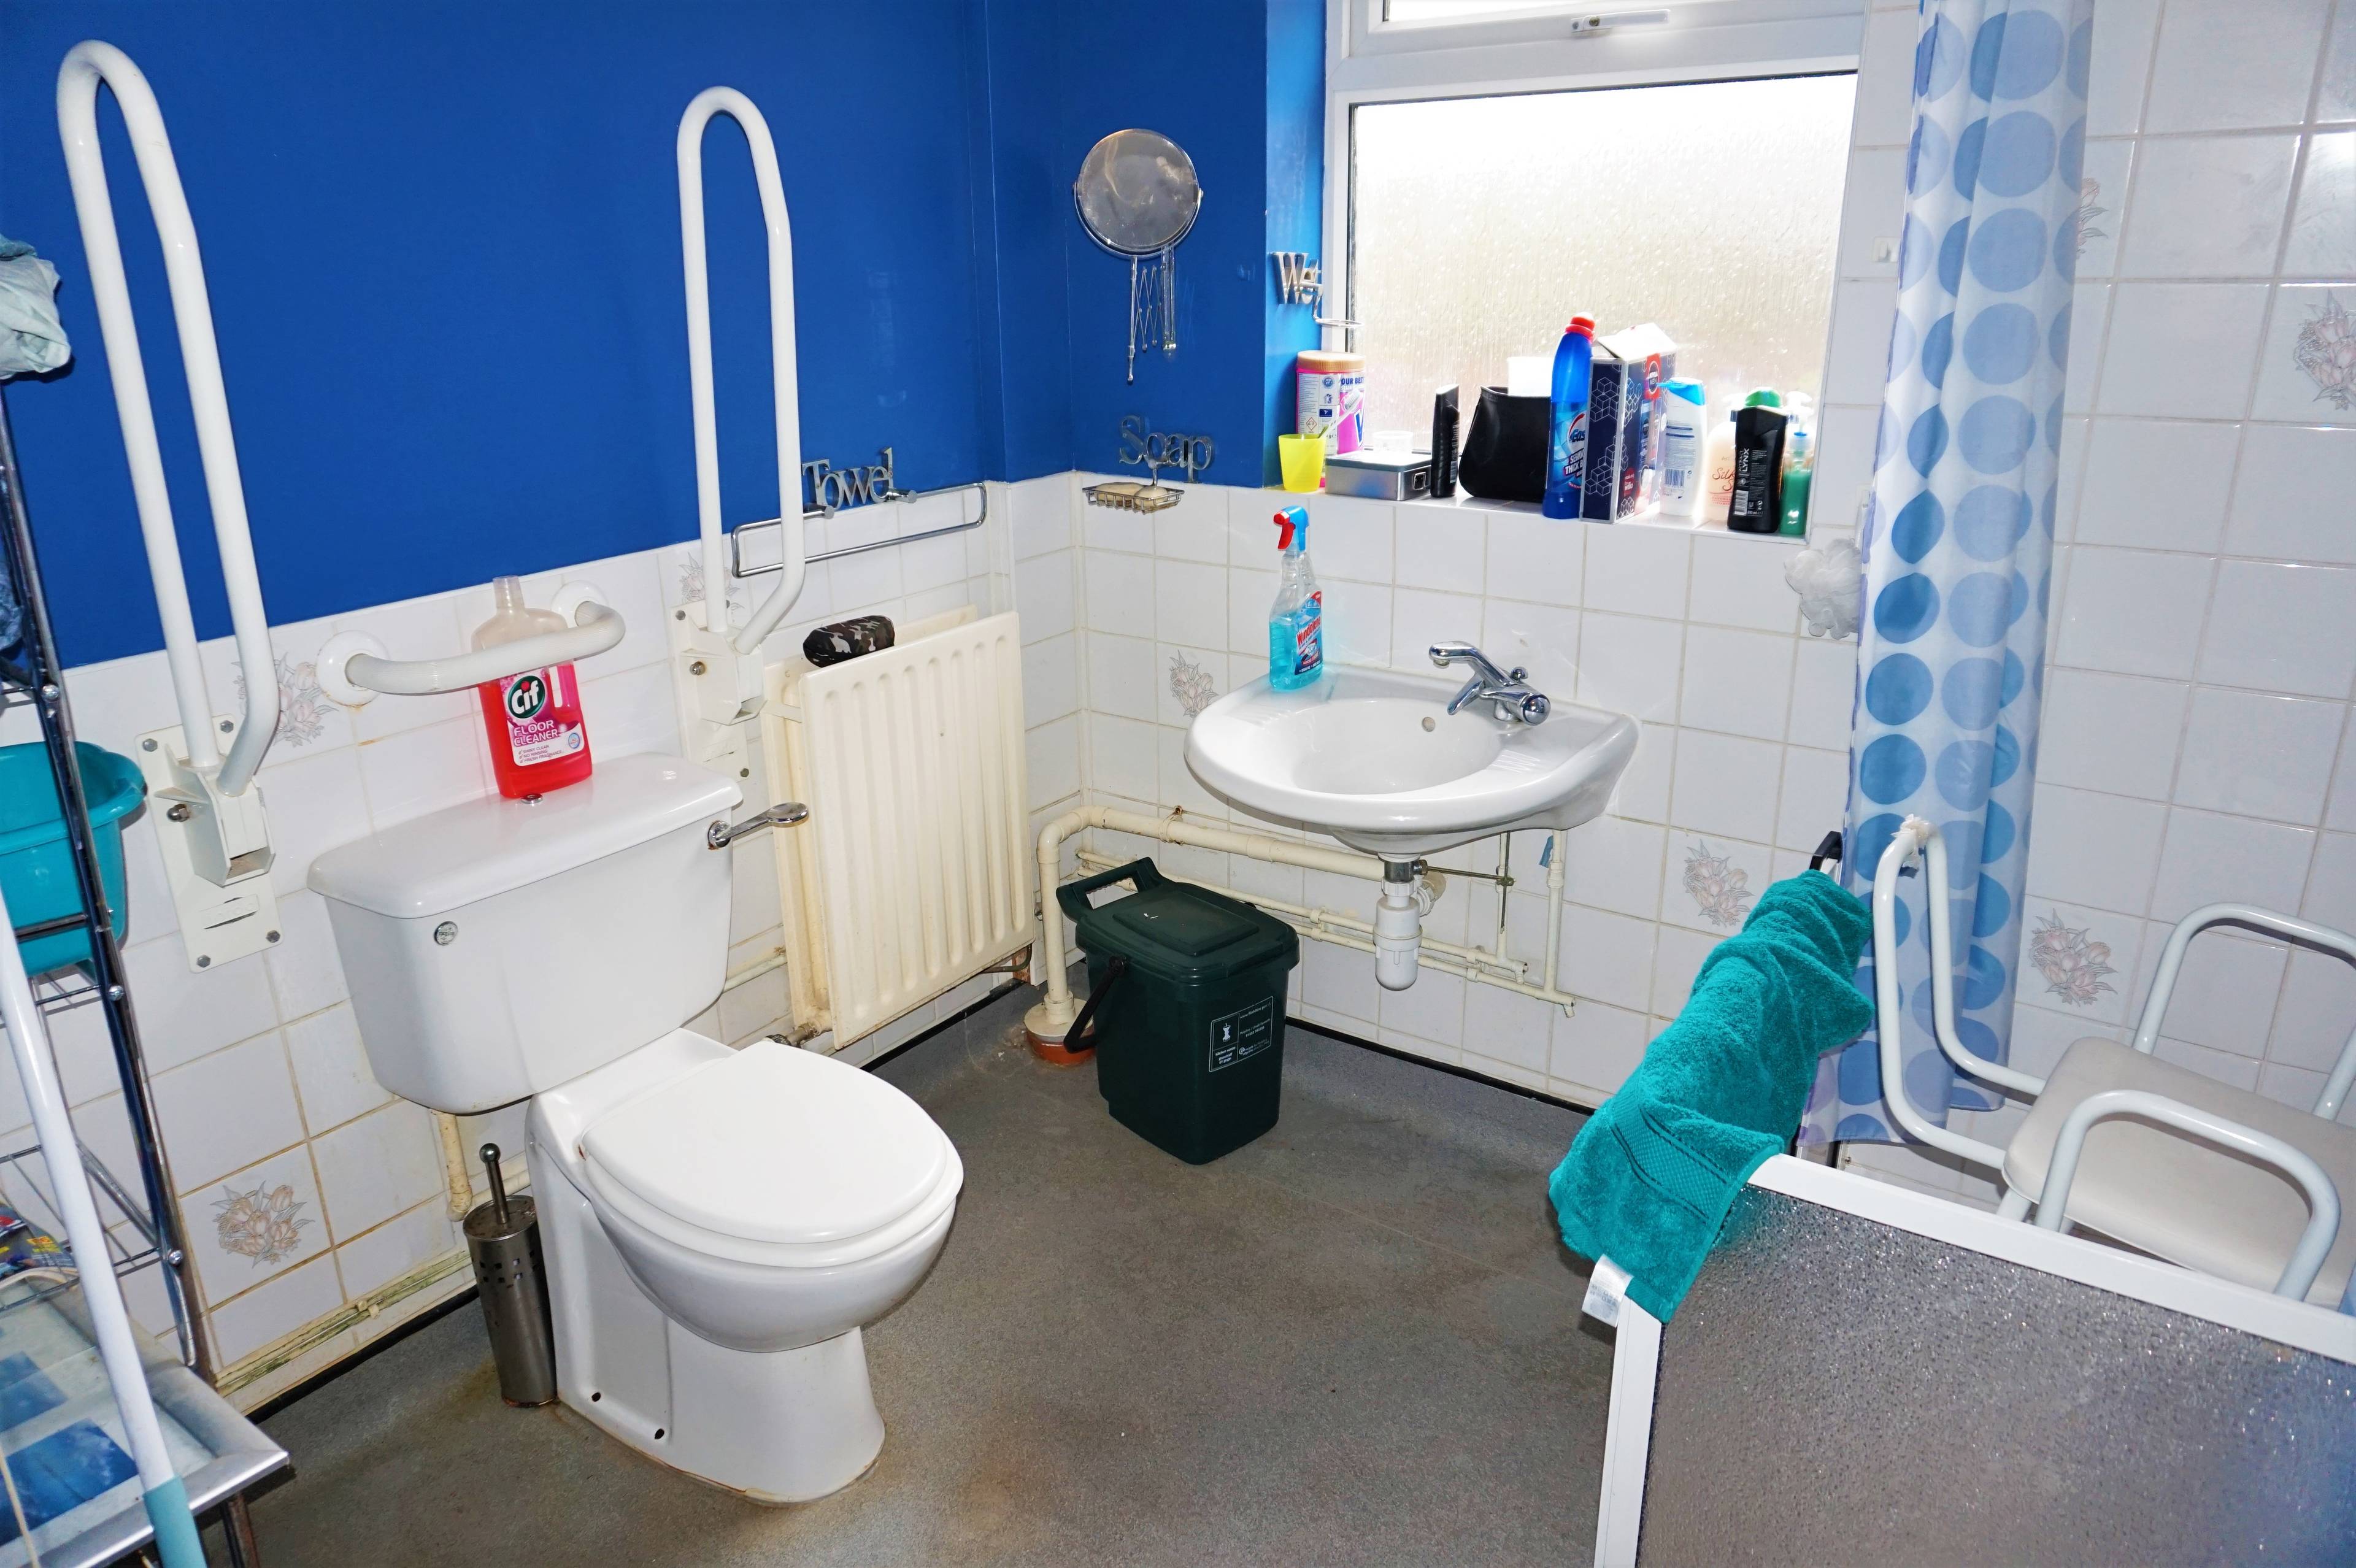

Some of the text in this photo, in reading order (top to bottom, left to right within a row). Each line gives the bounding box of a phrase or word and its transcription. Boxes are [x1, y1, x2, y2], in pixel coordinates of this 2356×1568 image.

[1569, 429, 1586, 443] Eas
[1120, 415, 1212, 484] Soap
[1565, 461, 1580, 475] THICK
[1712, 467, 1735, 480] Silk
[802, 447, 894, 510] Towel
[511, 680, 539, 715] Cif
[514, 720, 555, 737] FLOOR
[514, 729, 560, 747] CLEANER
[538, 750, 563, 759] FRAGRANCE
